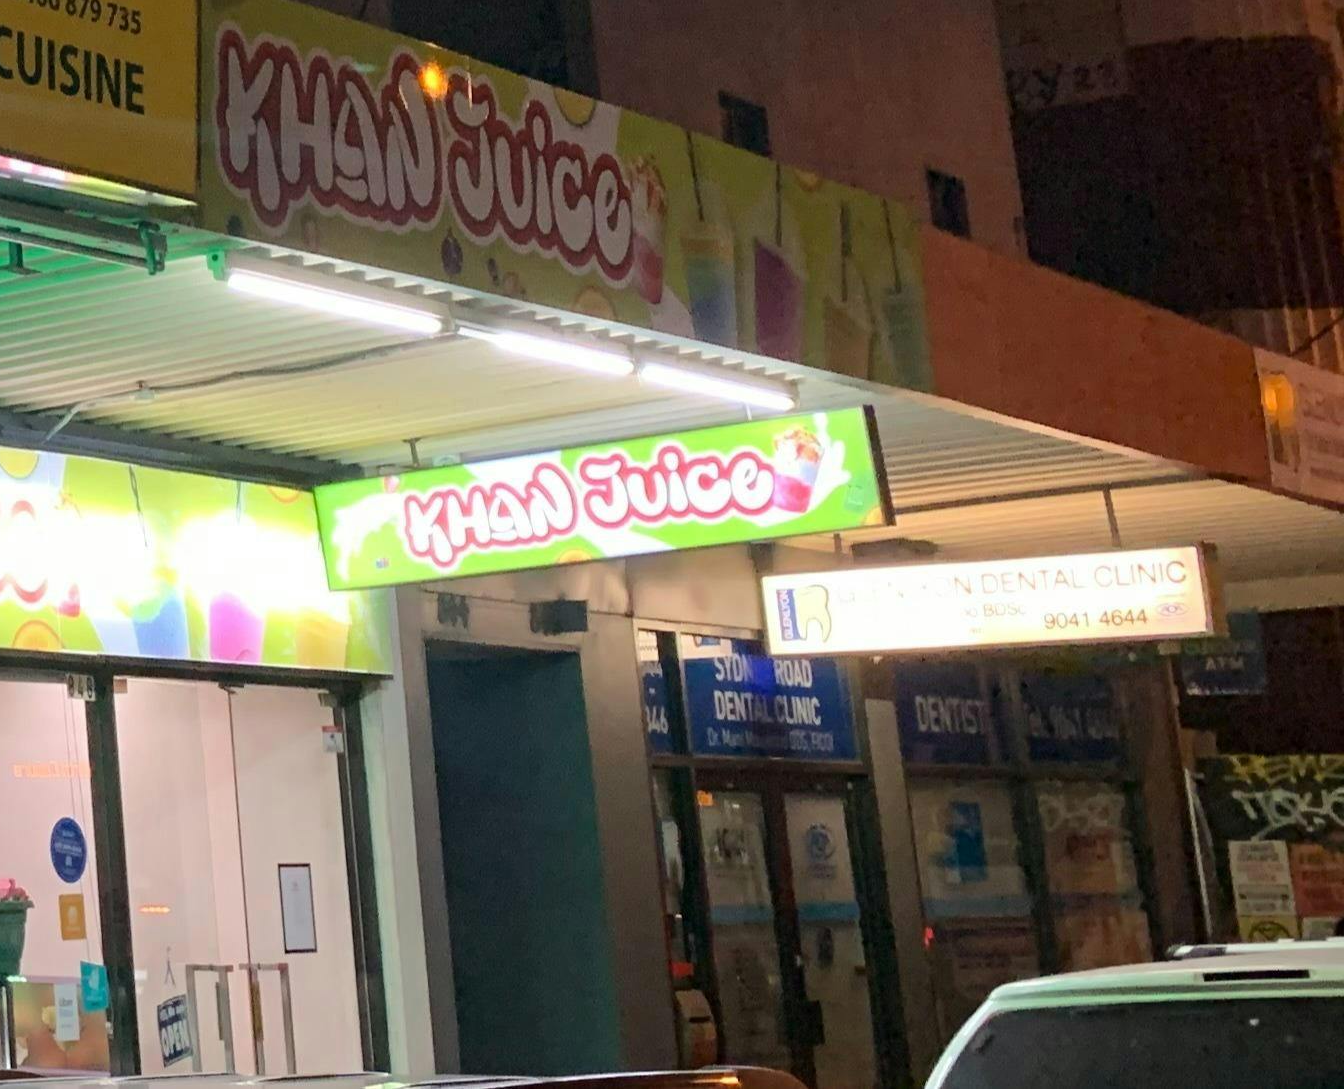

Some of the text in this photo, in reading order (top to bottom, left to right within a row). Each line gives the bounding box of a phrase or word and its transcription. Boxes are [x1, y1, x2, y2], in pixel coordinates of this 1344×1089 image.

[107, 0, 143, 36] 735
[217, 27, 635, 283] KHAN Juice
[403, 444, 776, 568] KHAN Juice
[981, 568, 1087, 595] DENTAL
[1093, 559, 1188, 588] CLINIC
[1043, 608, 1149, 630] 9041 4644
[713, 690, 822, 727] DENTAL CLINIC
